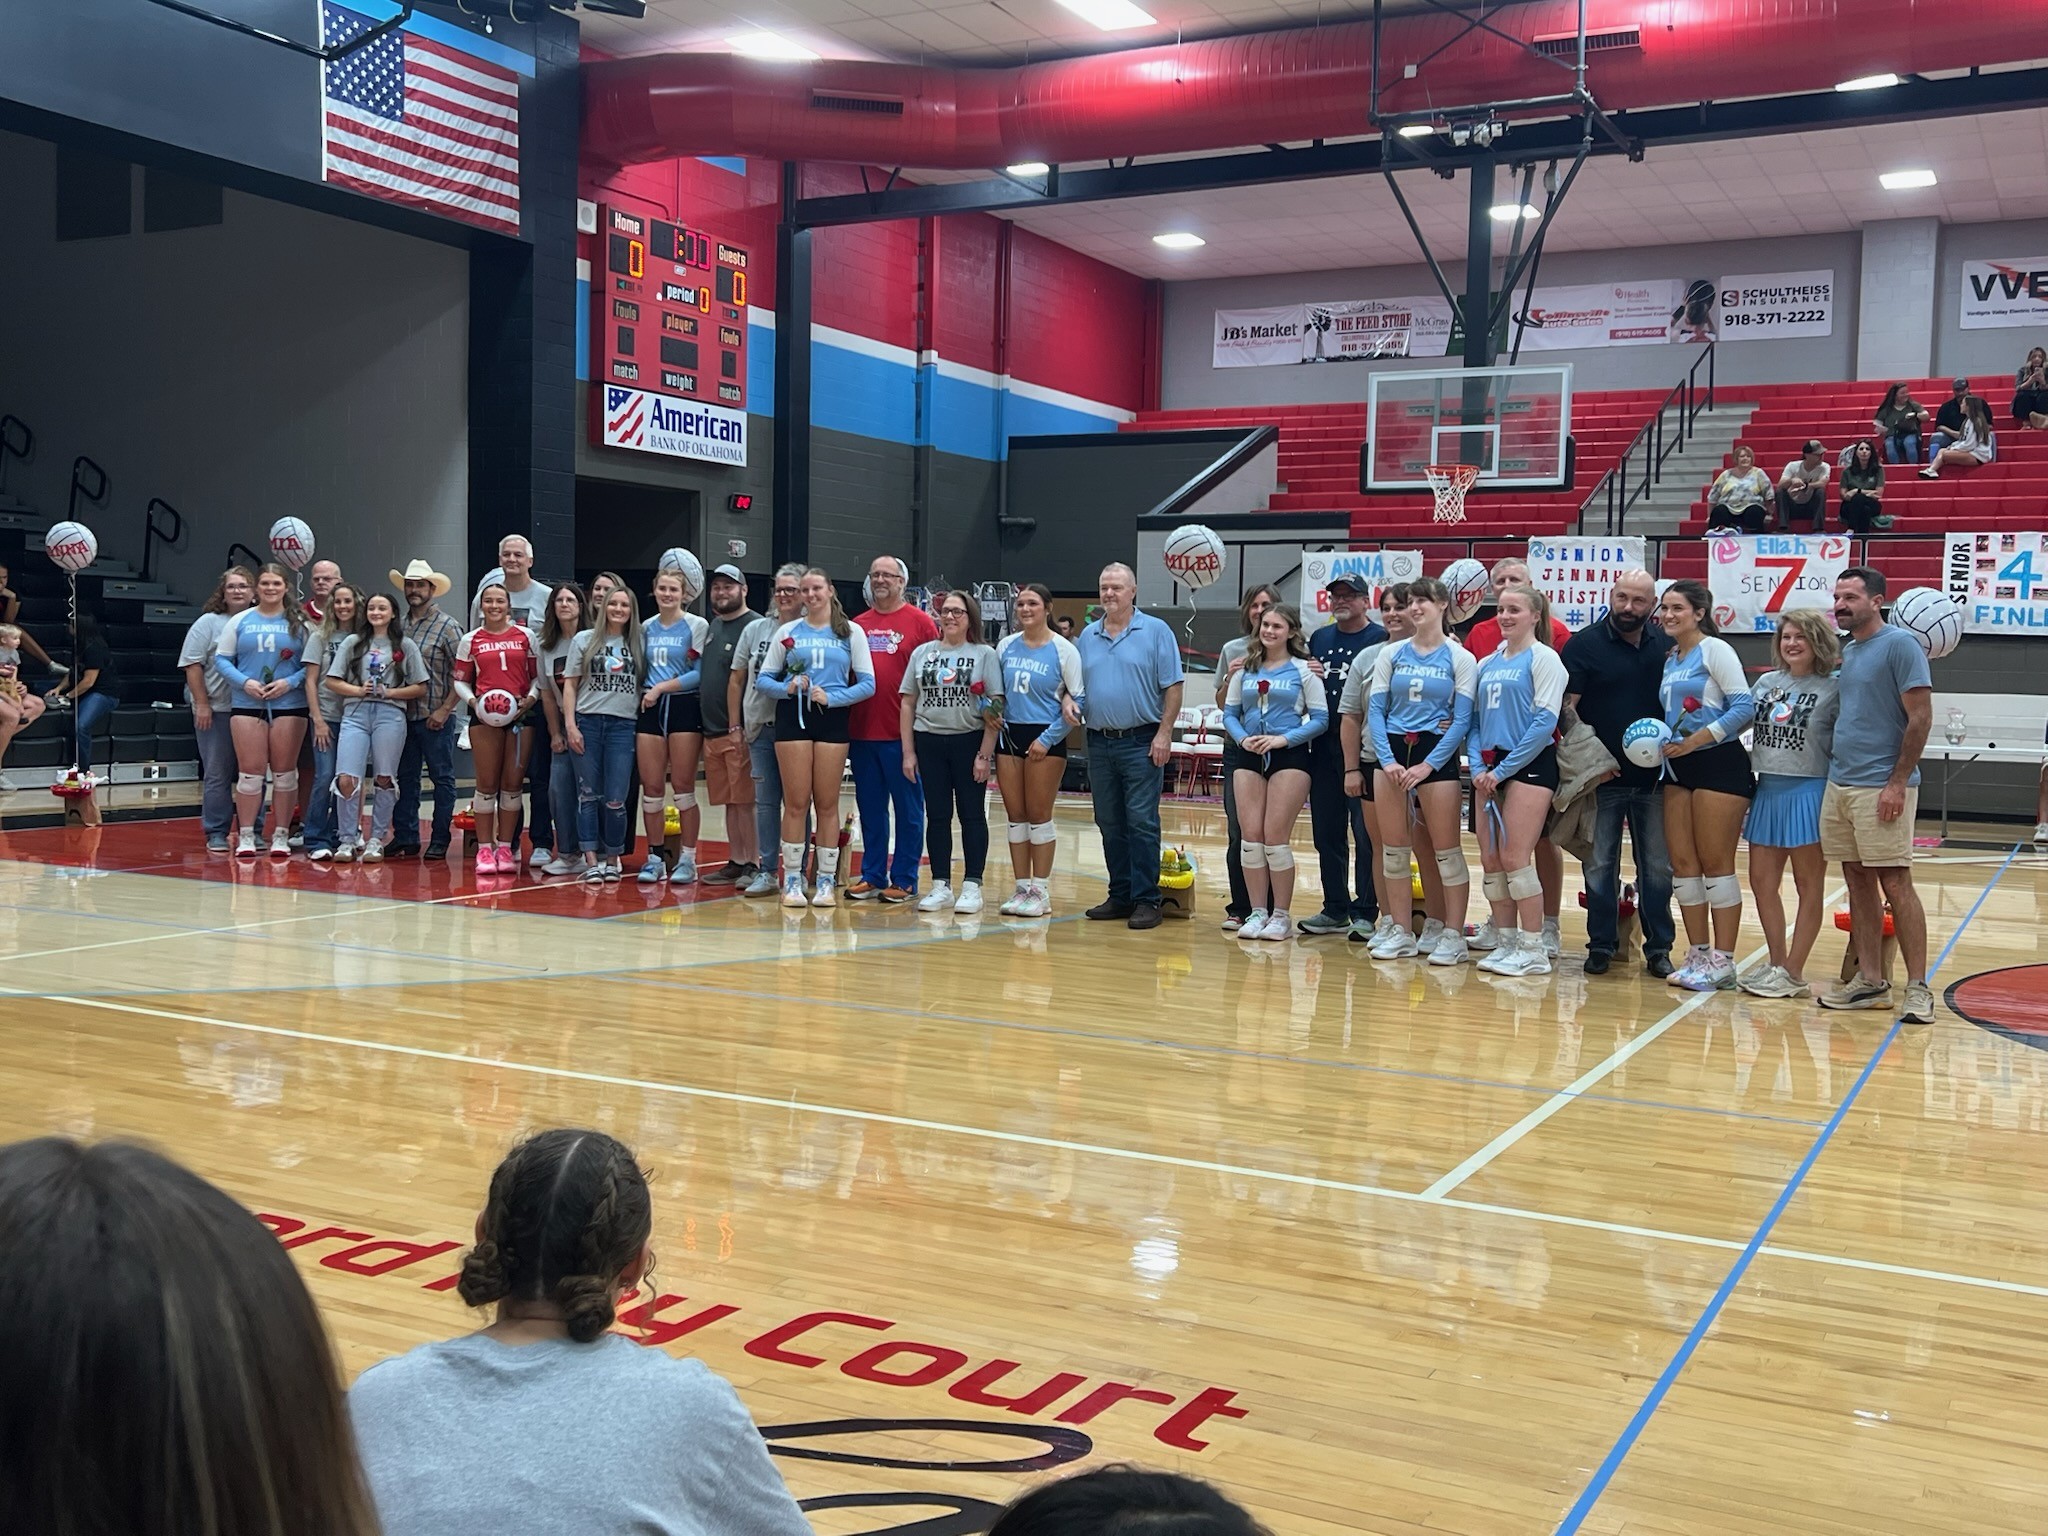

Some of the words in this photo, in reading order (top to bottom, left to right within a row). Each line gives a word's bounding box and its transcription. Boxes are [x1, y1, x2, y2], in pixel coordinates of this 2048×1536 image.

[614, 212, 641, 235] Home
[718, 244, 747, 267] Guests
[666, 285, 695, 304] period
[1743, 285, 1830, 298] SCHULTHEISS
[1743, 295, 1830, 306] INSURANCE
[615, 302, 638, 321] fouls
[1531, 308, 1611, 321] Collinsville
[1725, 310, 1825, 326] 918-371-2222
[666, 314, 694, 334] player
[1221, 326, 1248, 341] JB's
[1250, 323, 1298, 339] Market
[1335, 318, 1353, 331] THE
[1356, 316, 1379, 330] FEED
[1382, 313, 1412, 328] STORE
[719, 327, 740, 347] fouls
[613, 360, 639, 381] match
[665, 371, 694, 391] weight
[718, 383, 741, 402] match
[650, 398, 743, 444] American
[650, 434, 676, 451] BANK
[678, 440, 691, 454] OF
[692, 441, 743, 462] OKLAHOMA
[1545, 545, 1624, 562] SENIOR
[1330, 554, 1385, 580] ANNA
[1949, 542, 1971, 605] SENIOR
[1998, 550, 2043, 600] 4
[1755, 557, 1807, 613] 7
[257, 633, 275, 652] 14
[478, 641, 523, 653] COLLINSVILLE
[647, 636, 683, 647] OLLINSVILLE
[499, 651, 508, 671] 1
[653, 647, 668, 667] 10
[812, 648, 825, 669] 11
[1013, 670, 1031, 694] 13
[1409, 678, 1424, 702] 2
[923, 687, 939, 698] THE
[937, 697, 954, 707] SET
[1486, 682, 1503, 710] 12
[1766, 736, 1783, 748] SET
[1772, 725, 1805, 740] FINAL
[743, 1310, 1250, 1452] Court
